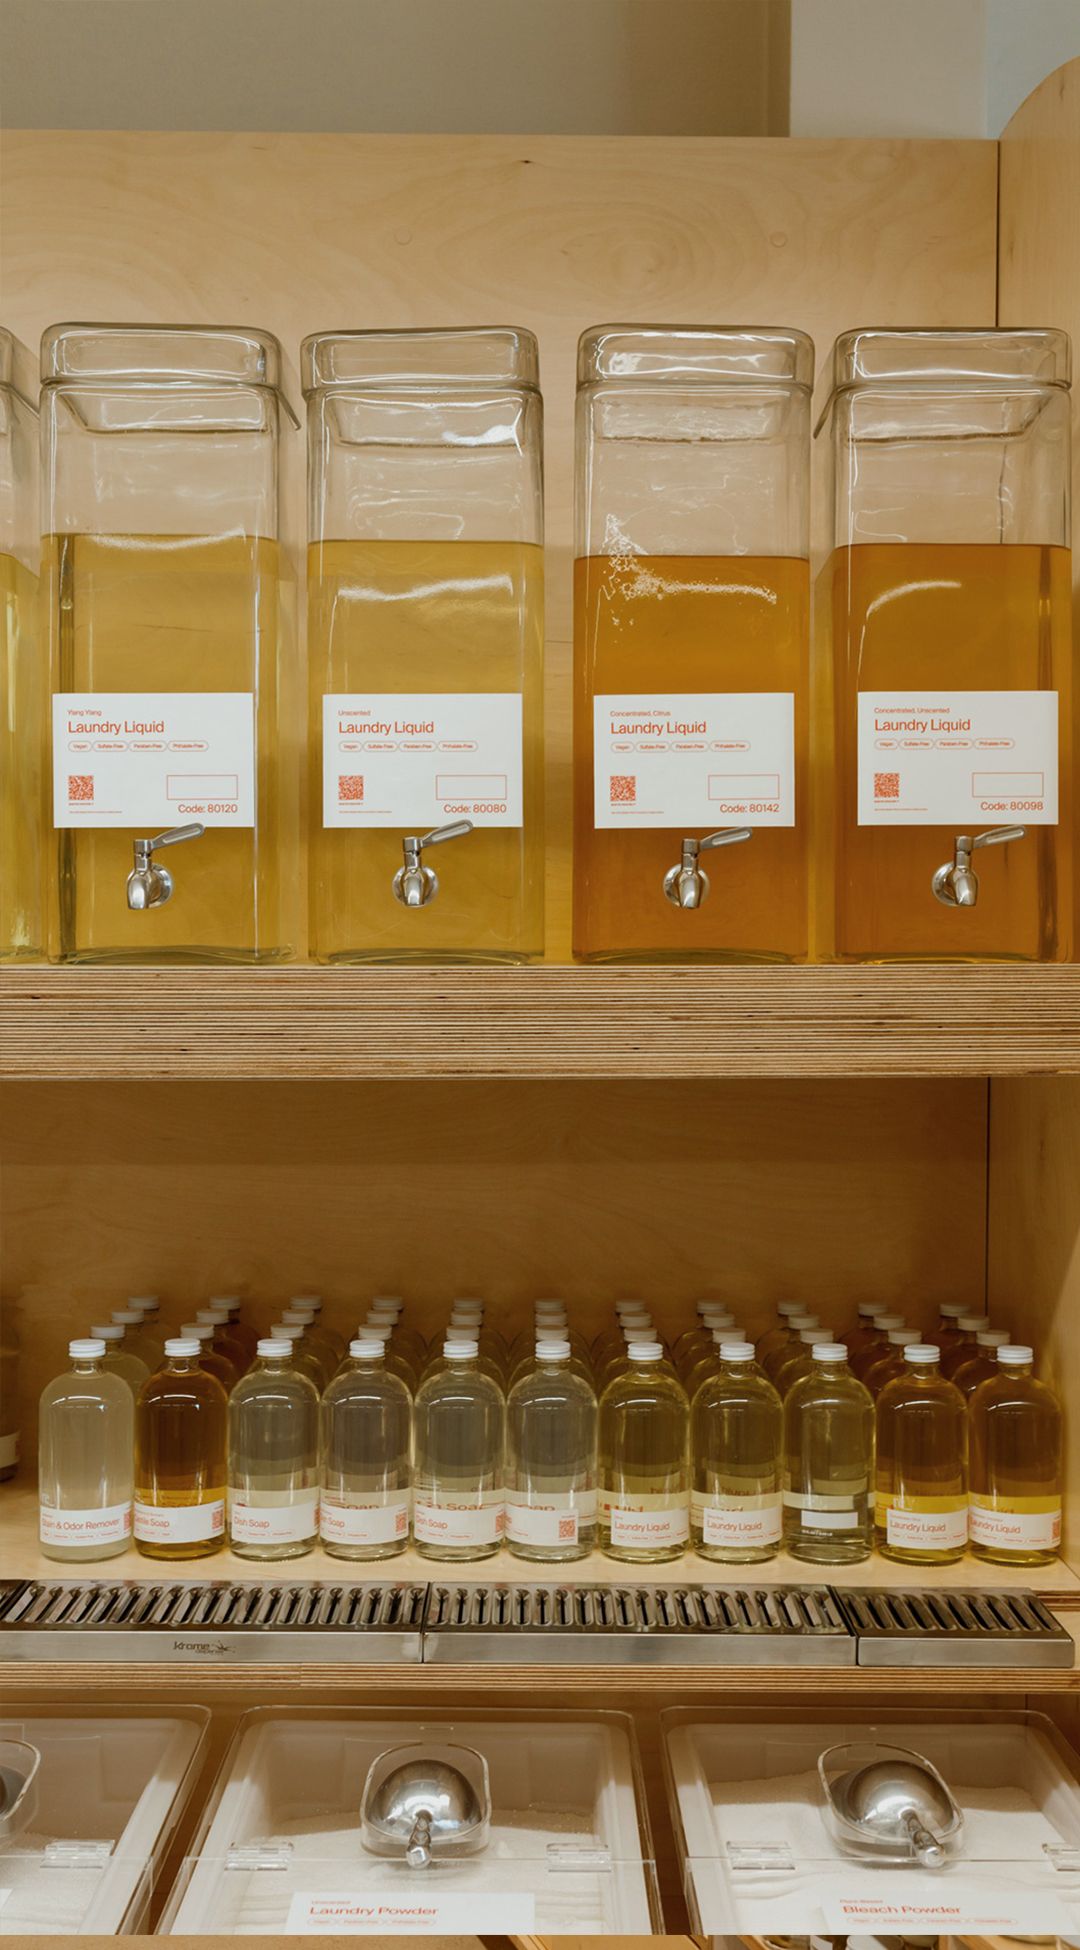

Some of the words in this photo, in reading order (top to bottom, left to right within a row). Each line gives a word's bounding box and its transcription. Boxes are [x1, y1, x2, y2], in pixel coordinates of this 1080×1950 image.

[67, 709, 84, 717] Ylang
[86, 709, 102, 717] Ylang
[68, 721, 121, 735] Laundry
[124, 721, 165, 735] Liquid
[339, 721, 391, 736] Laundry
[394, 721, 434, 735] Liquid
[610, 722, 663, 736] Laundry
[667, 721, 707, 736] Liquid
[874, 719, 927, 733] Laundry
[931, 719, 971, 733] Liquid
[178, 804, 205, 813] Code:
[207, 804, 238, 813] 80120
[444, 804, 471, 813] Code:
[473, 804, 507, 813] 80080
[720, 803, 748, 813] Code:
[749, 803, 780, 813] 80142
[980, 801, 1008, 811] Code:
[1010, 801, 1043, 811] 80098
[56, 1521, 62, 1529] &
[63, 1522, 84, 1531] Odor
[85, 1518, 120, 1529] Remover
[150, 1518, 169, 1529] Soap
[249, 1518, 270, 1530] Soap
[428, 1519, 448, 1530] Soap
[615, 1521, 645, 1532] Laundry
[647, 1522, 670, 1532] Liquid
[707, 1520, 738, 1532] Laundry
[739, 1522, 762, 1531] Liquid
[890, 1520, 920, 1533] Laundry
[922, 1523, 946, 1532] Liquid
[996, 1525, 1021, 1534] Liquid
[310, 1907, 375, 1916] Laundry
[378, 1906, 439, 1915] Powder
[843, 1905, 899, 1914] Bleach
[901, 1905, 961, 1914] Powder
